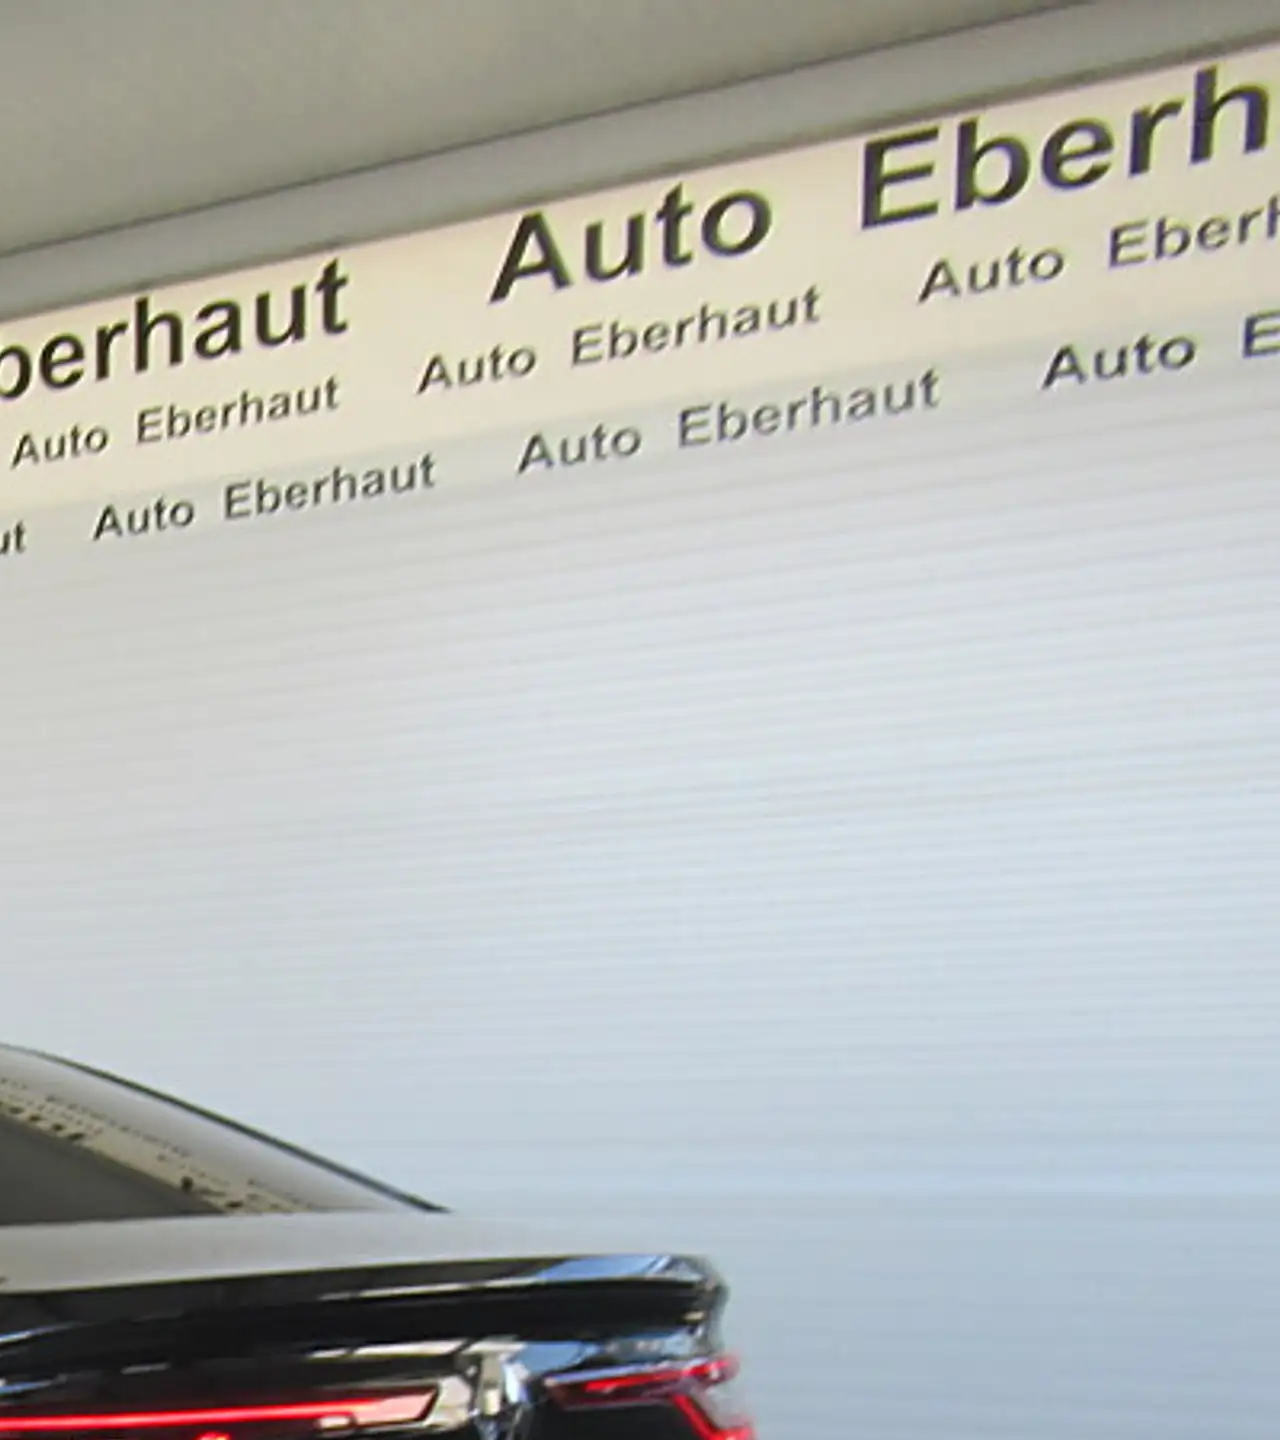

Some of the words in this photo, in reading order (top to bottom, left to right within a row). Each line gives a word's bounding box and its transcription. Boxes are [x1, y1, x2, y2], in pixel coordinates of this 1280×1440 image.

[490, 183, 771, 303] Auto
[860, 66, 1269, 230] Eberh
[919, 248, 1063, 303] Auto
[418, 346, 536, 394] Auto
[573, 286, 819, 365] Eberhaut
[1043, 336, 1195, 388] Auto
[13, 426, 108, 467] Auto
[138, 377, 337, 443] Eberhaut
[518, 424, 641, 474] Auto
[679, 369, 938, 447] Eberhaut
[94, 499, 194, 541] Auto
[225, 454, 434, 520] Eberhaut
